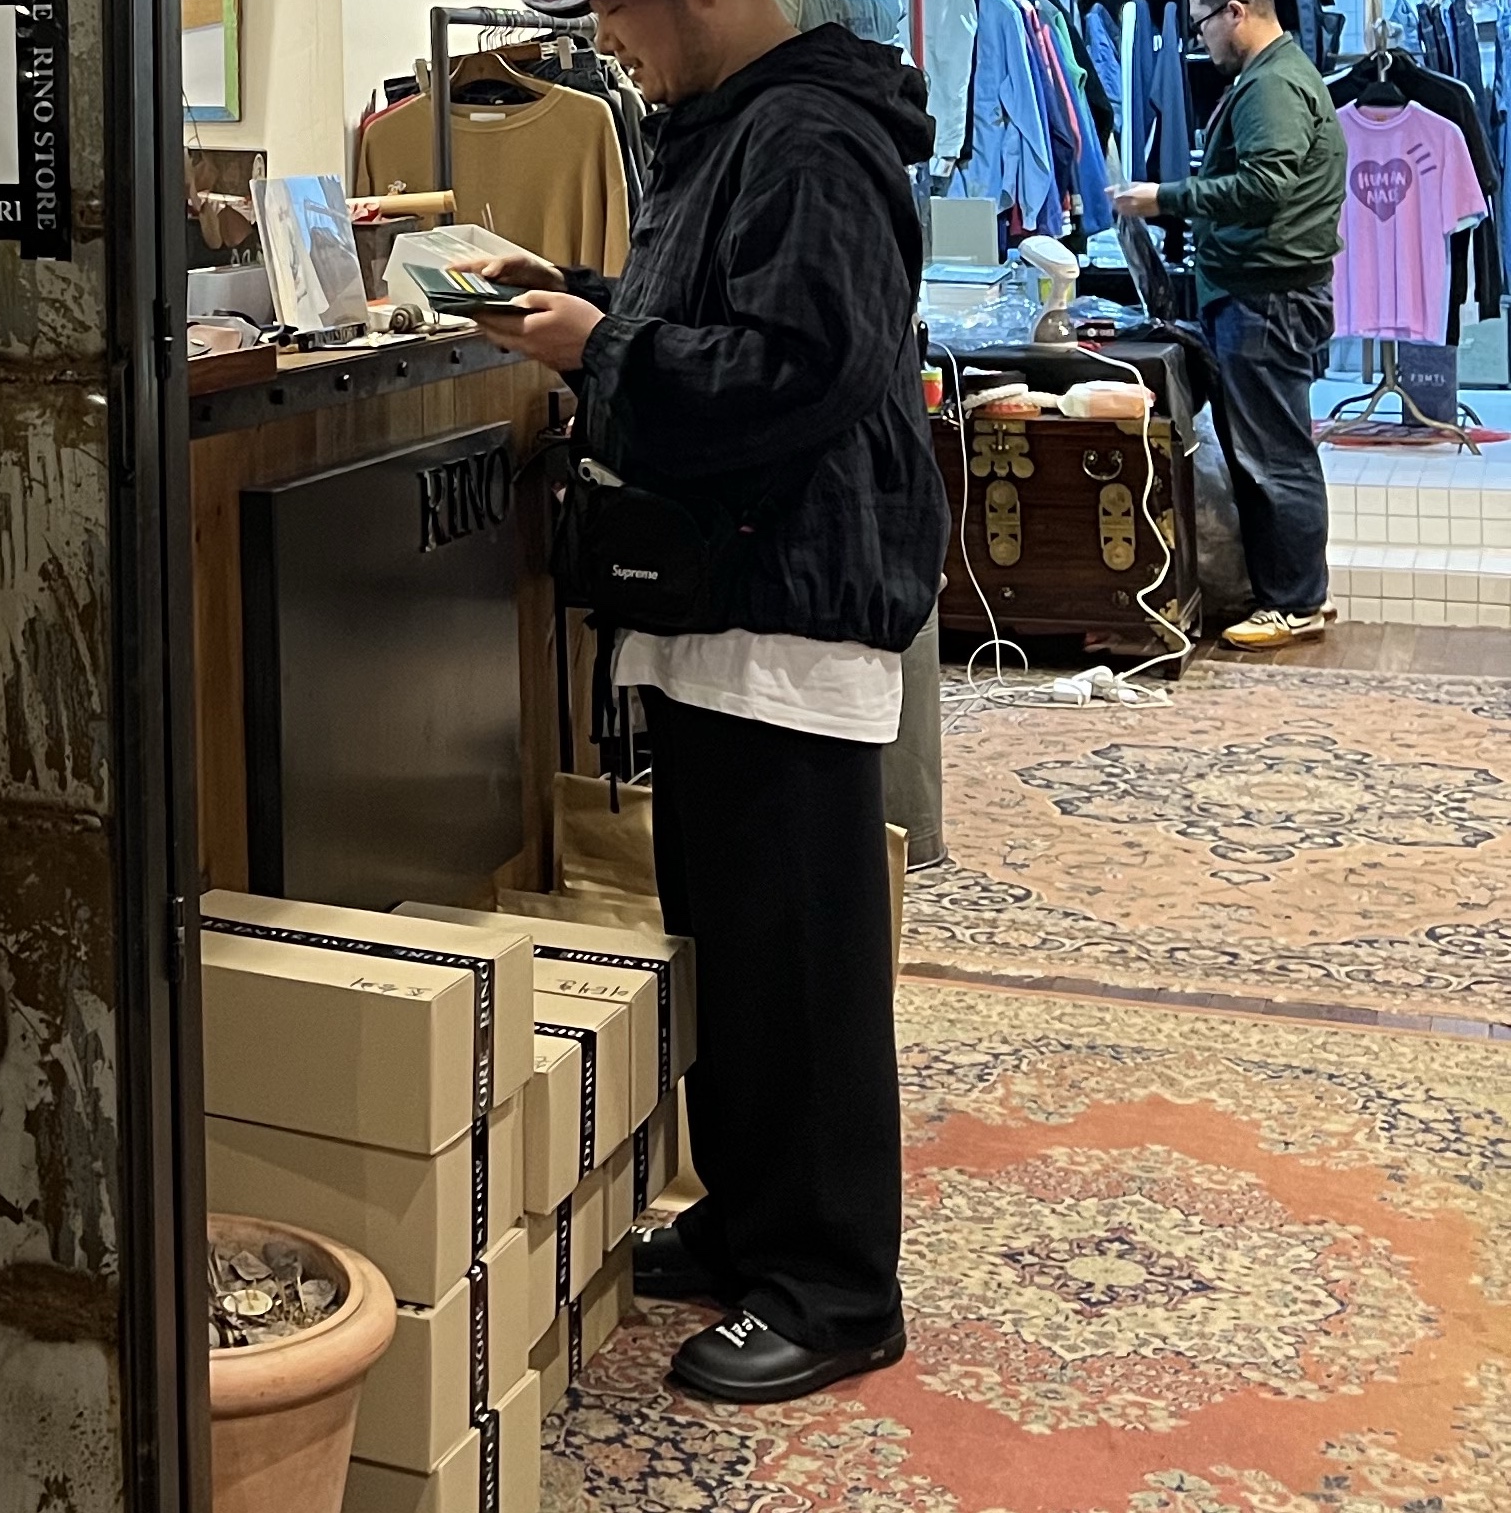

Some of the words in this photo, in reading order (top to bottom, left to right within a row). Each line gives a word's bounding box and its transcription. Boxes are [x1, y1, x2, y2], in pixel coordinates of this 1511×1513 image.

[33, 46, 55, 123] RINO
[34, 131, 57, 231] STORE
[1357, 170, 1407, 190] HUMAN
[418, 445, 512, 554] RINO
[611, 563, 659, 581] Supreme
[478, 1049, 489, 1108] ORE
